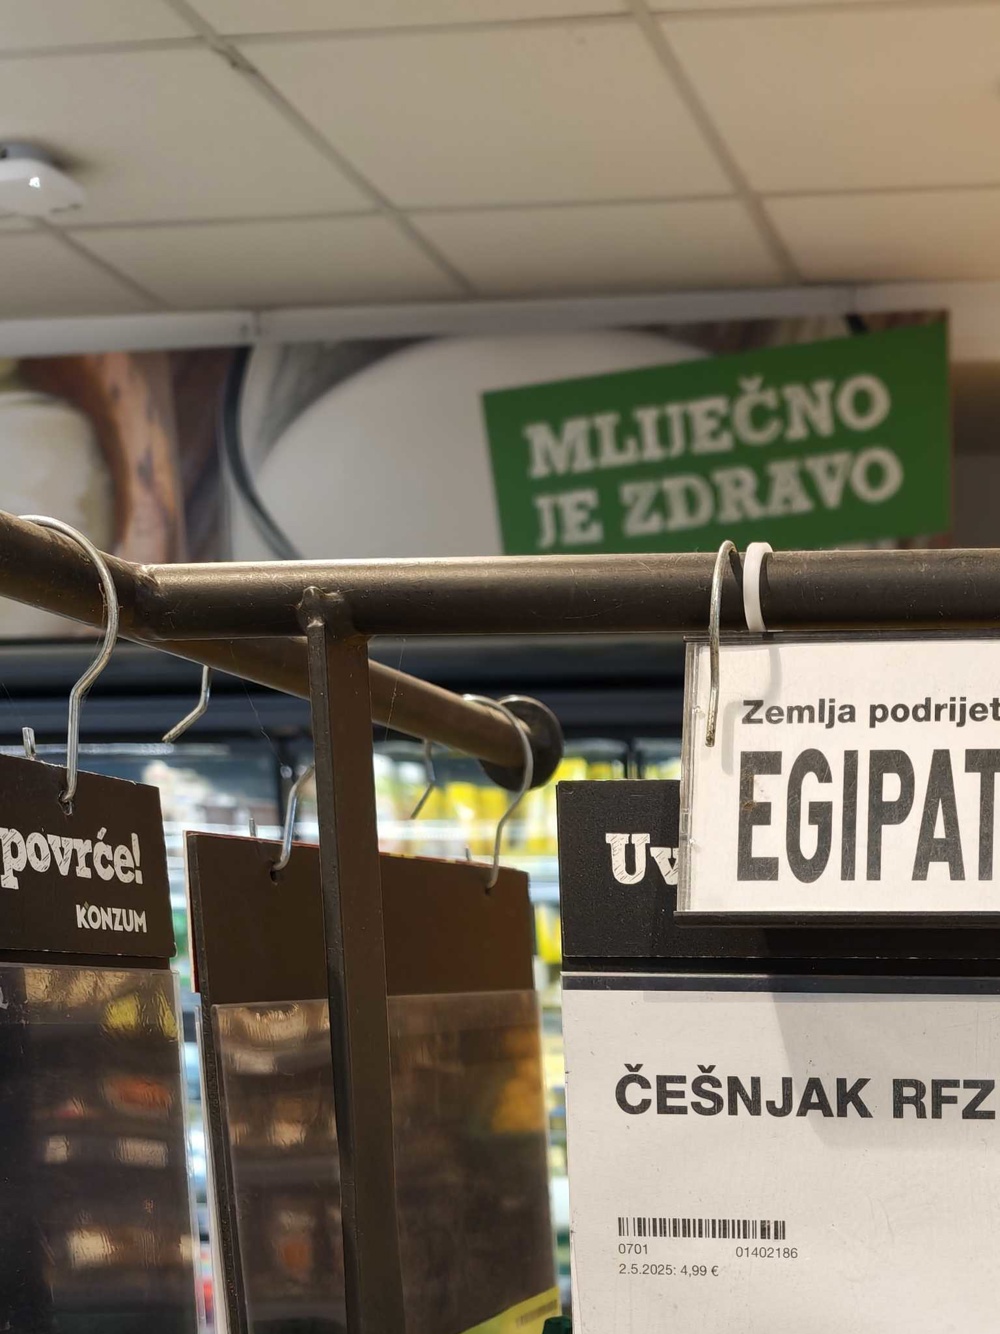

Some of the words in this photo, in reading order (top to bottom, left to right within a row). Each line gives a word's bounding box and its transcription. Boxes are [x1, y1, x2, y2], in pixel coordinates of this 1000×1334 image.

[523, 374, 891, 478] MLIJEČNO
[533, 487, 603, 549] JE
[620, 447, 904, 537] ZDRAVO
[742, 699, 857, 728] Zemlja
[0, 827, 144, 890] povrće!
[76, 903, 147, 933] KONZUM
[615, 1063, 873, 1118] ČEŠNJAK
[893, 1078, 996, 1120] RFZ
[618, 1243, 648, 1255] 0701
[735, 1246, 798, 1259] 01402186
[619, 1264, 677, 1276] 2.5.2025:
[680, 1265, 707, 1277] 4,99
[711, 1265, 719, 1276] €
